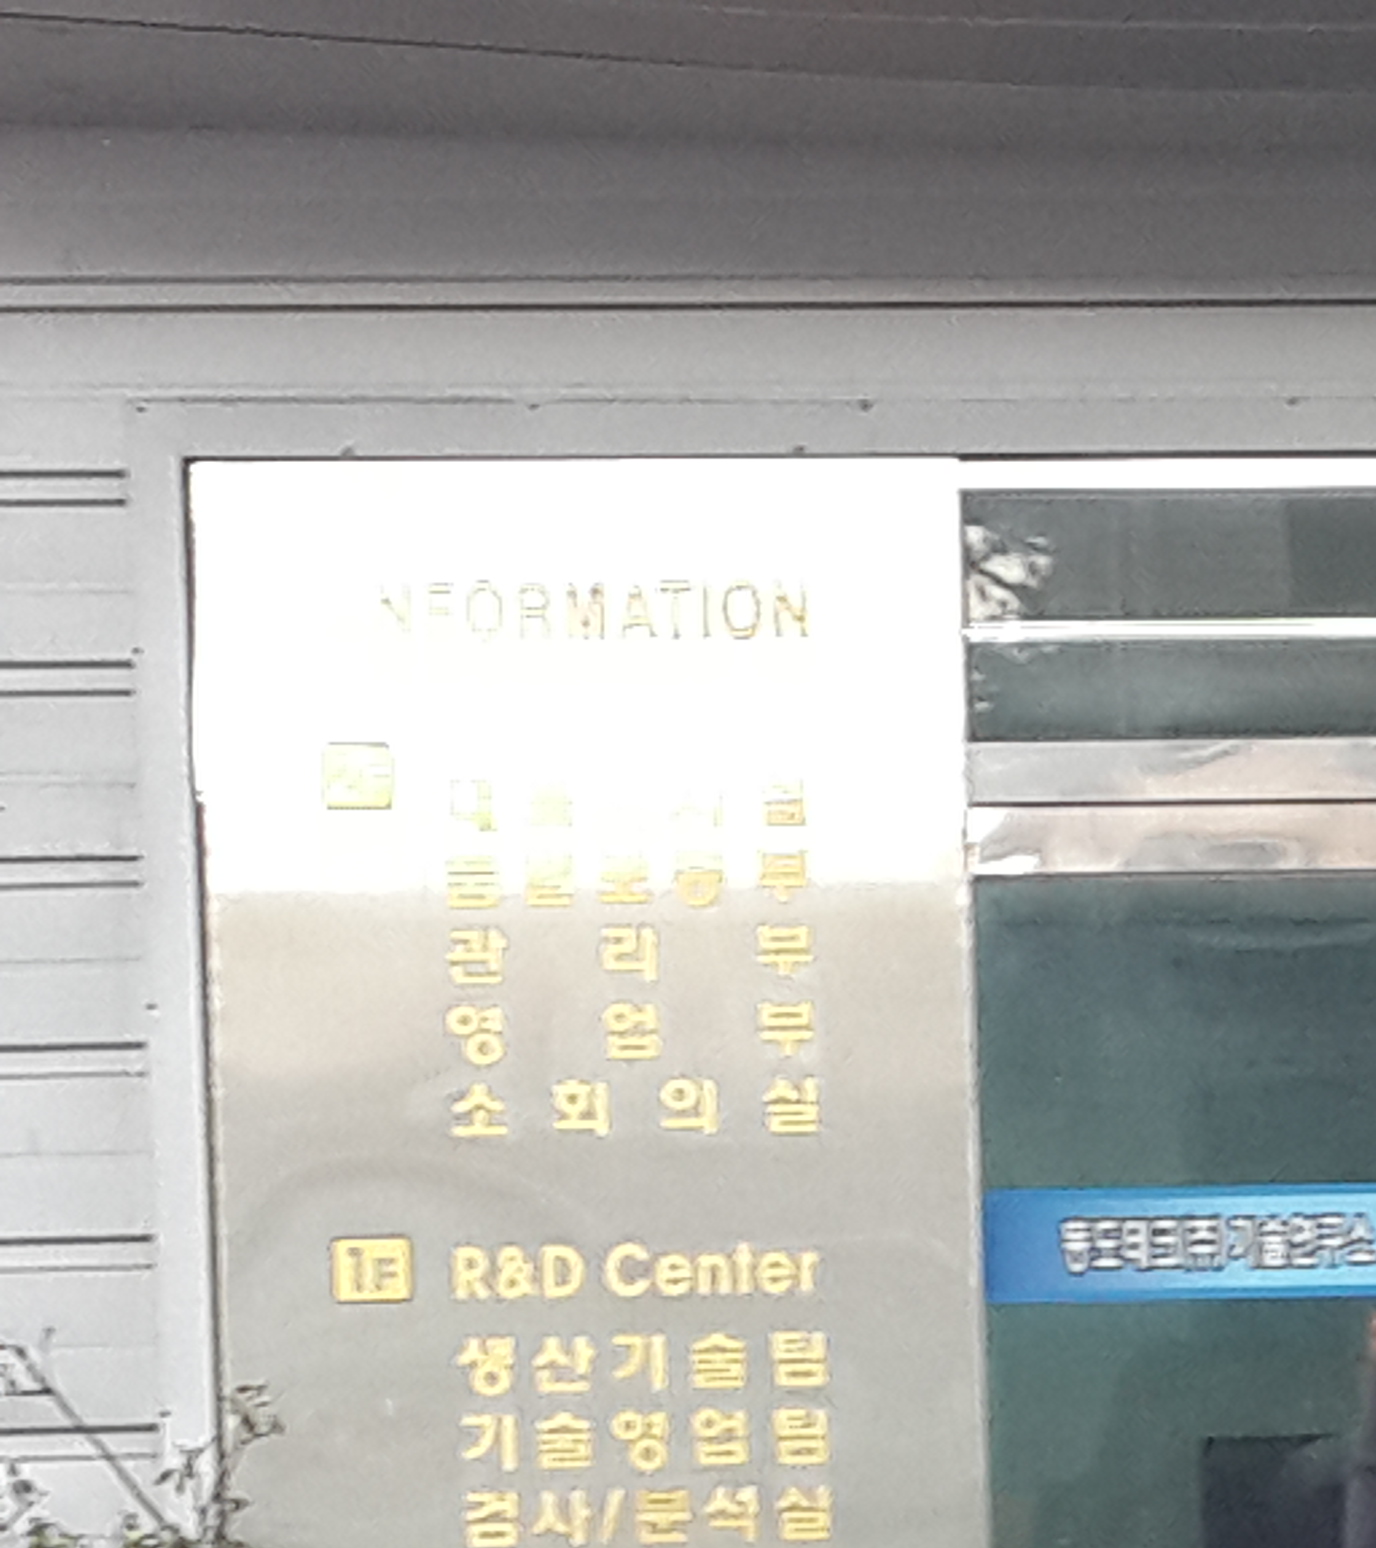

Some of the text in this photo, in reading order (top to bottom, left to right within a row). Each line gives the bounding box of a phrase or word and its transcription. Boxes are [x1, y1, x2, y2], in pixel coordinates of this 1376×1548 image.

[378, 579, 811, 640] NFORMATION
[451, 1241, 822, 1300] R&D Center
[455, 1330, 830, 1396] 생산기술팀
[459, 1406, 832, 1472] 기술영업팀
[463, 1485, 836, 1548] 검사/분석실
